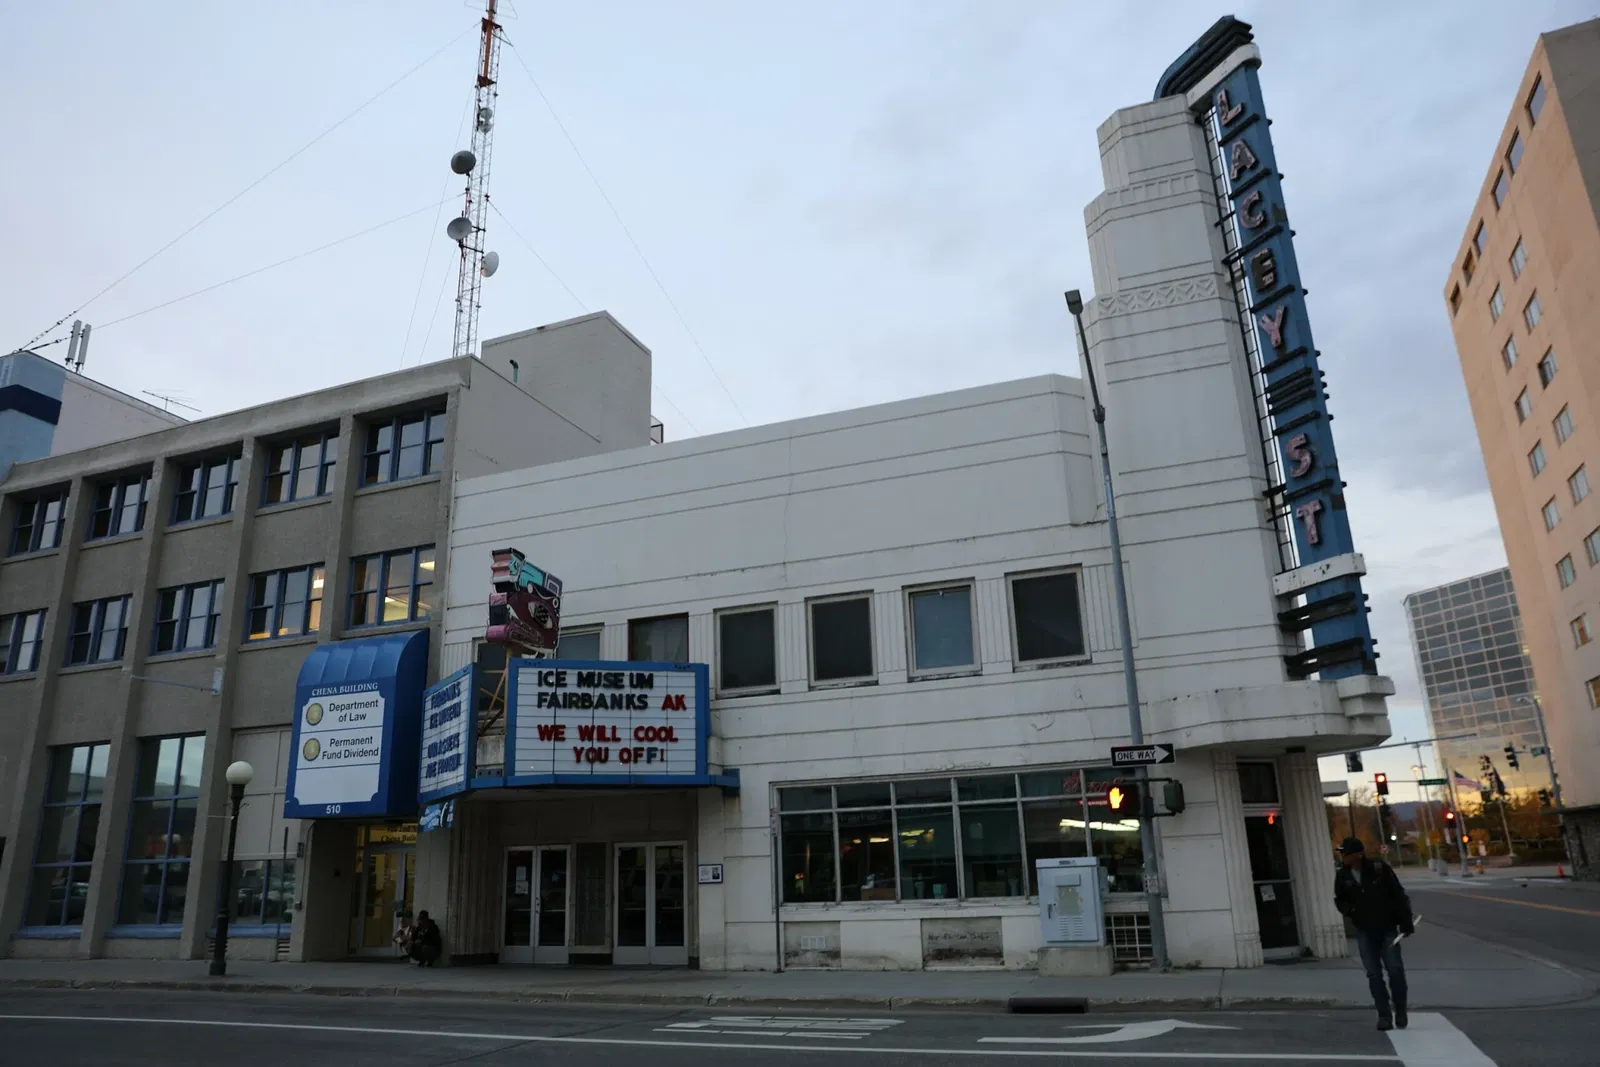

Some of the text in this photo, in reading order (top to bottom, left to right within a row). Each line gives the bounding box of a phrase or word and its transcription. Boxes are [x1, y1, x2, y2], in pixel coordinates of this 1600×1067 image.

[1217, 88, 1323, 545] LACEY ST
[537, 670, 654, 689] ICE MUSEUM
[312, 682, 378, 696] CHENA BUILDING
[329, 699, 379, 712] Department
[537, 691, 687, 711] FAIRBANKS AK
[339, 713, 367, 722] of Law
[537, 724, 679, 743] WE WILL COOL
[330, 736, 373, 747] Permanent
[322, 747, 379, 759] Fund Dividend
[573, 746, 664, 764] YOU OFF!
[1117, 750, 1156, 760] ONE WAY
[325, 804, 341, 814] 510
